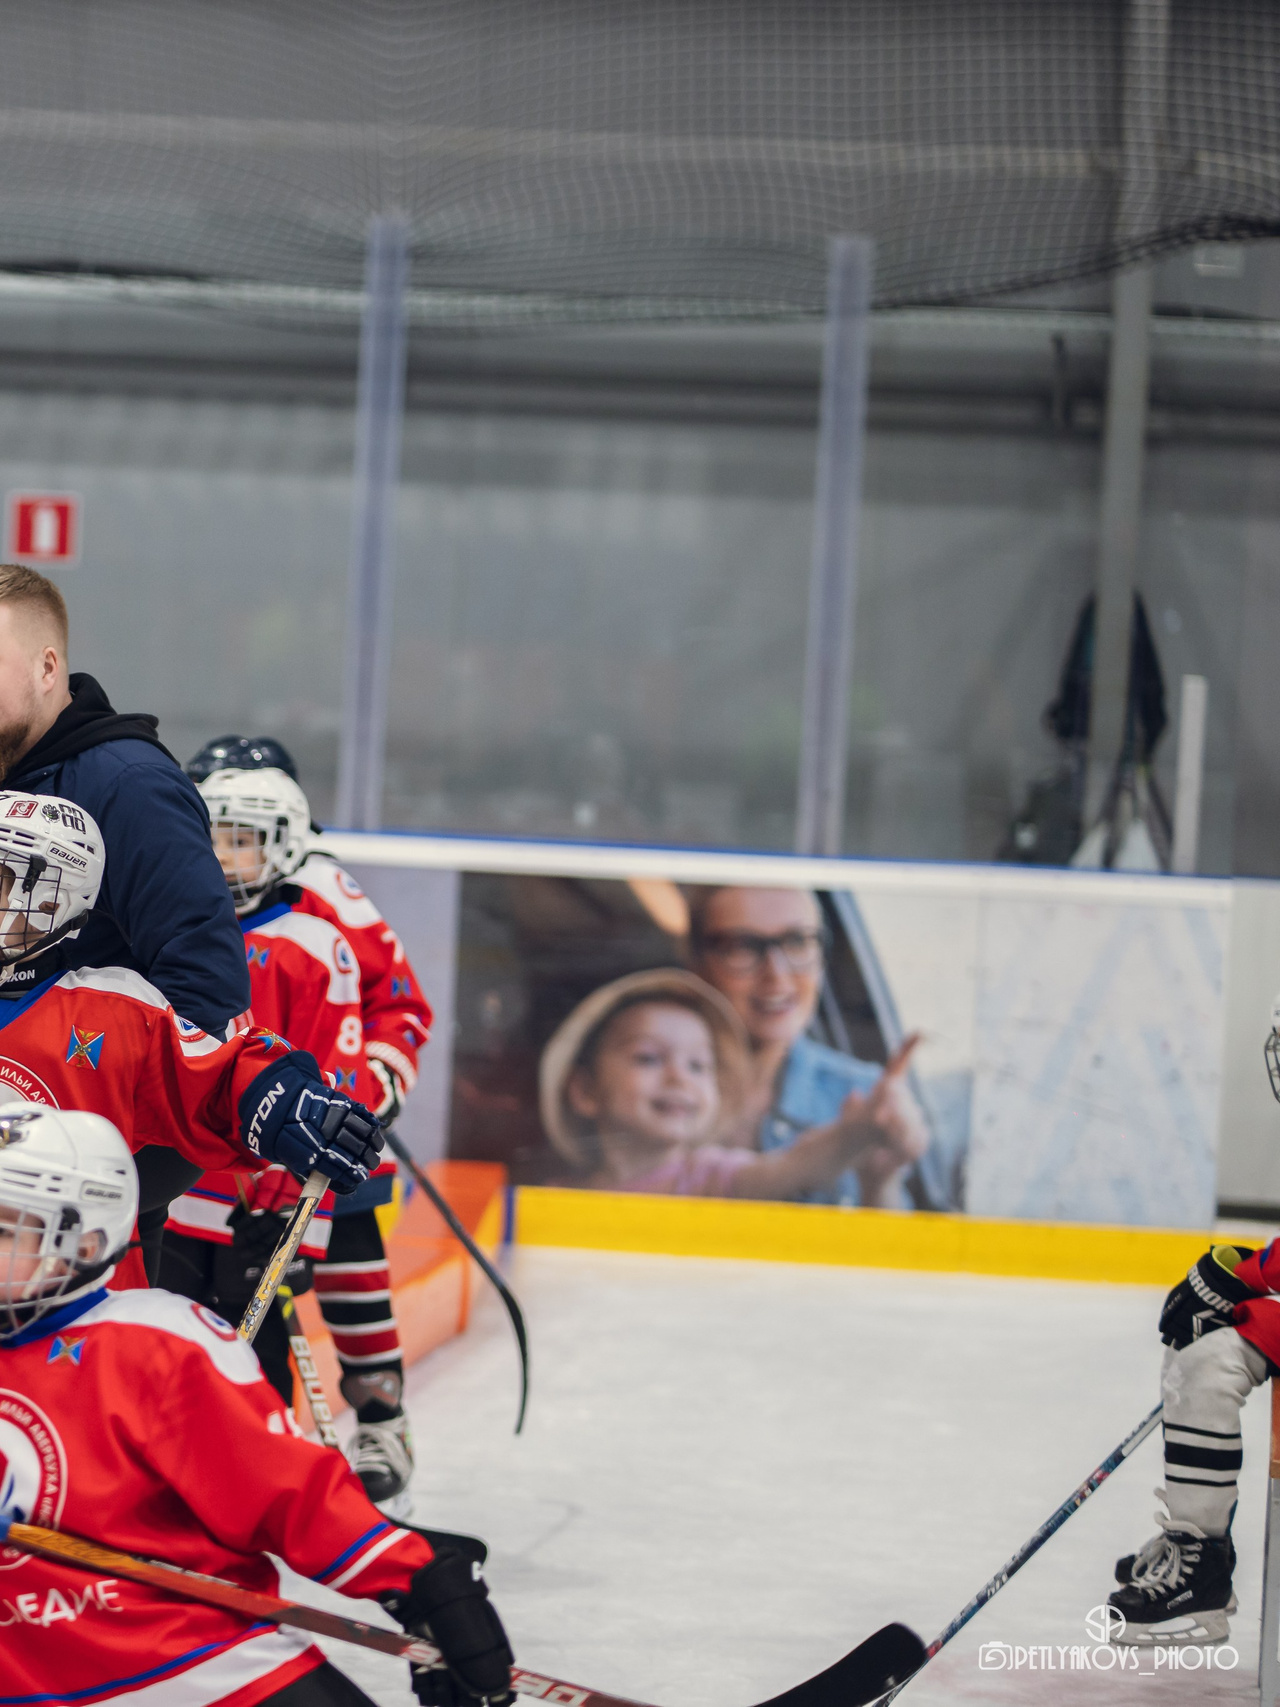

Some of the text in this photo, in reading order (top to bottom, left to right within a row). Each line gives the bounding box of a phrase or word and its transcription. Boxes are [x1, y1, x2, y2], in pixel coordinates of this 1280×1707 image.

[49, 847, 87, 868] BAUER
[337, 1014, 362, 1056] 8
[0, 1066, 32, 1091] ИЛЬИ
[290, 1335, 339, 1446] BAUER
